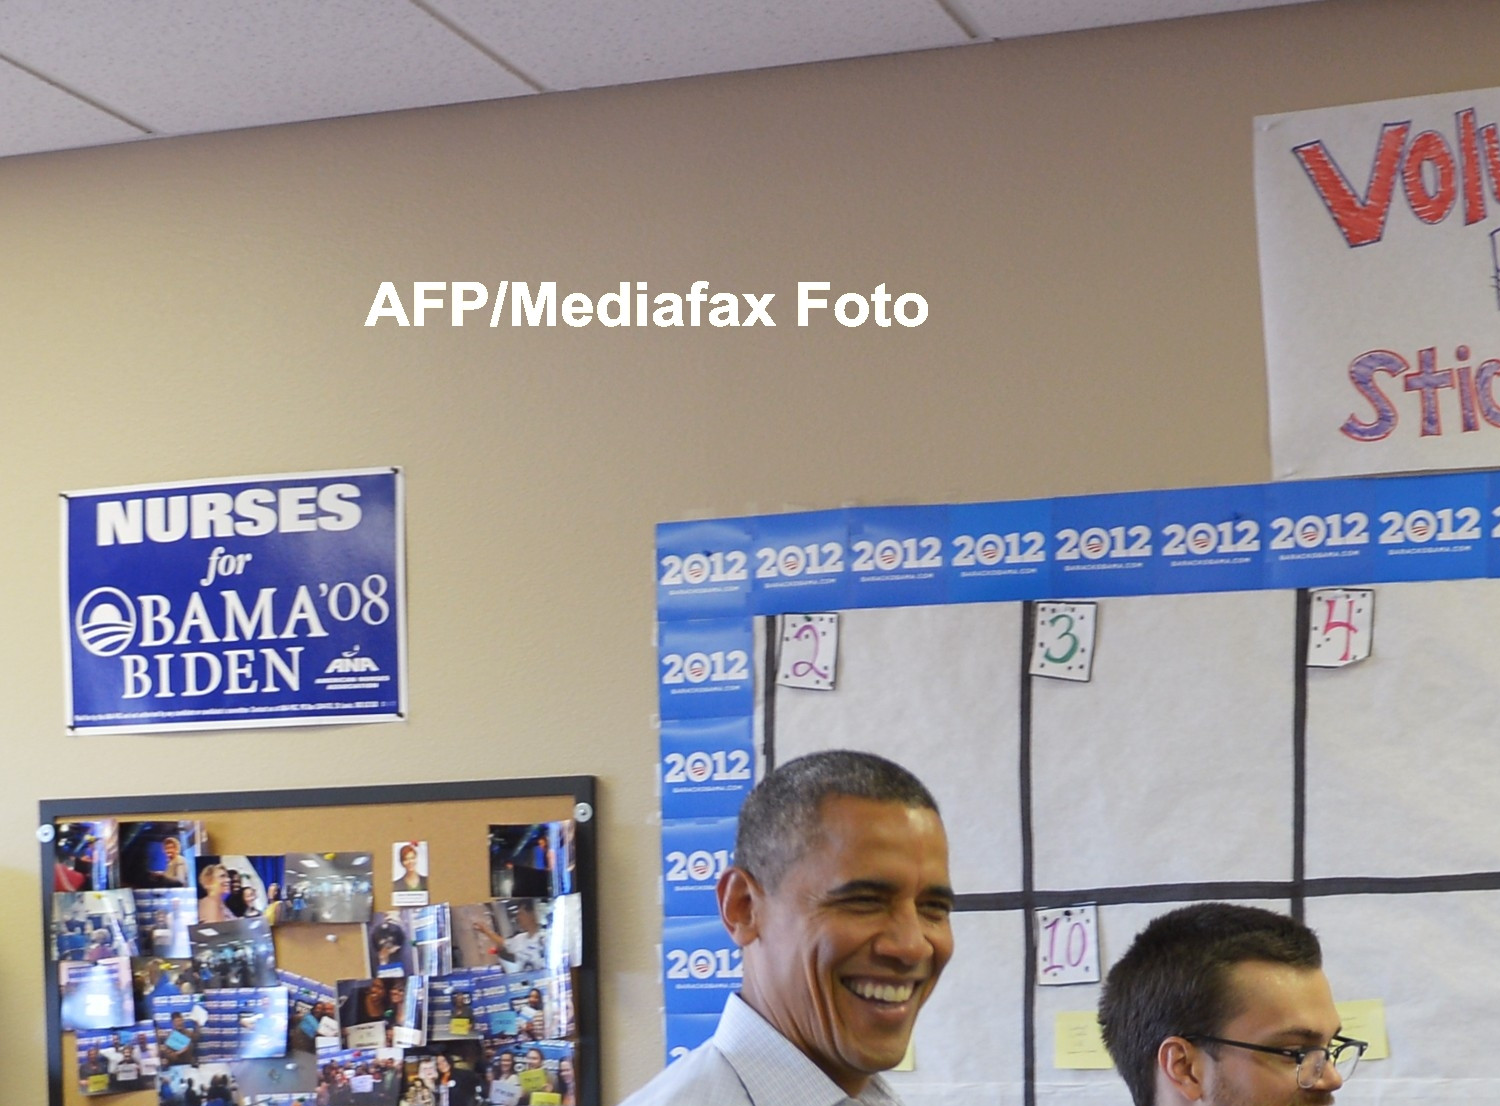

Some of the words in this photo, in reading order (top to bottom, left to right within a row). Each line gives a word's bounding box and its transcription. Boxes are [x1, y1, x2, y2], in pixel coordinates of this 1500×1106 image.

[97, 483, 362, 547] NURSES
[1270, 512, 1369, 549] 2012
[1378, 507, 1481, 544] 2012
[852, 537, 942, 571] 2012
[952, 532, 1045, 567] 2012
[1055, 525, 1152, 560] 2012
[1162, 520, 1260, 556] 2012
[200, 546, 252, 587] for
[660, 550, 748, 585] 2012
[755, 542, 844, 577] 2012
[1044, 616, 1079, 665] 3
[1321, 597, 1360, 662] 4
[662, 650, 748, 684] 2012
[790, 623, 829, 680] 2
[120, 647, 305, 699] BIDEN
[664, 749, 751, 783] 2012
[666, 850, 736, 882] 201
[1042, 917, 1088, 975] 10
